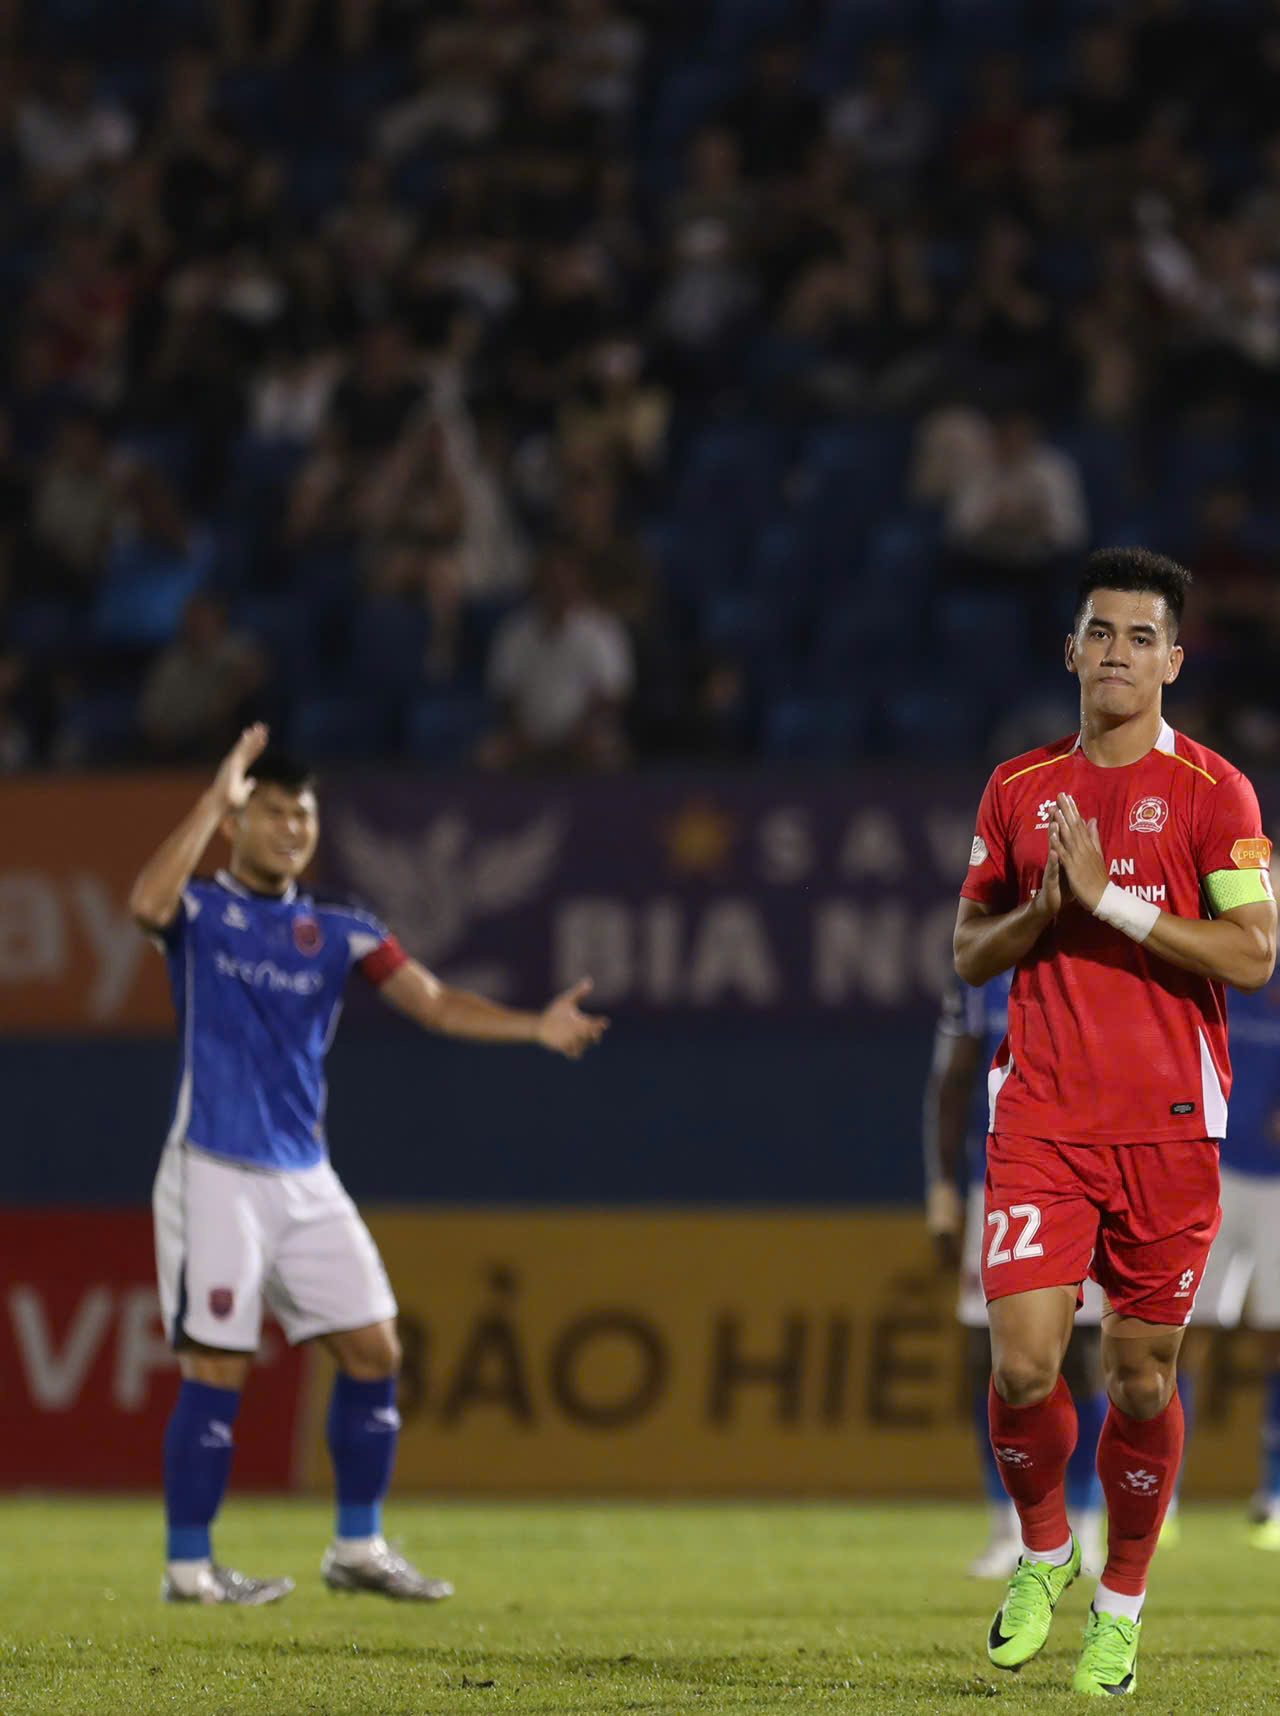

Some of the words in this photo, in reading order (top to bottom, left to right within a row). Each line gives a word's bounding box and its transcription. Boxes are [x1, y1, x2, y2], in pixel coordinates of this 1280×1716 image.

[1109, 858, 1135, 876] AN
[555, 898, 782, 1004] BIA
[987, 1204, 1044, 1269] 22
